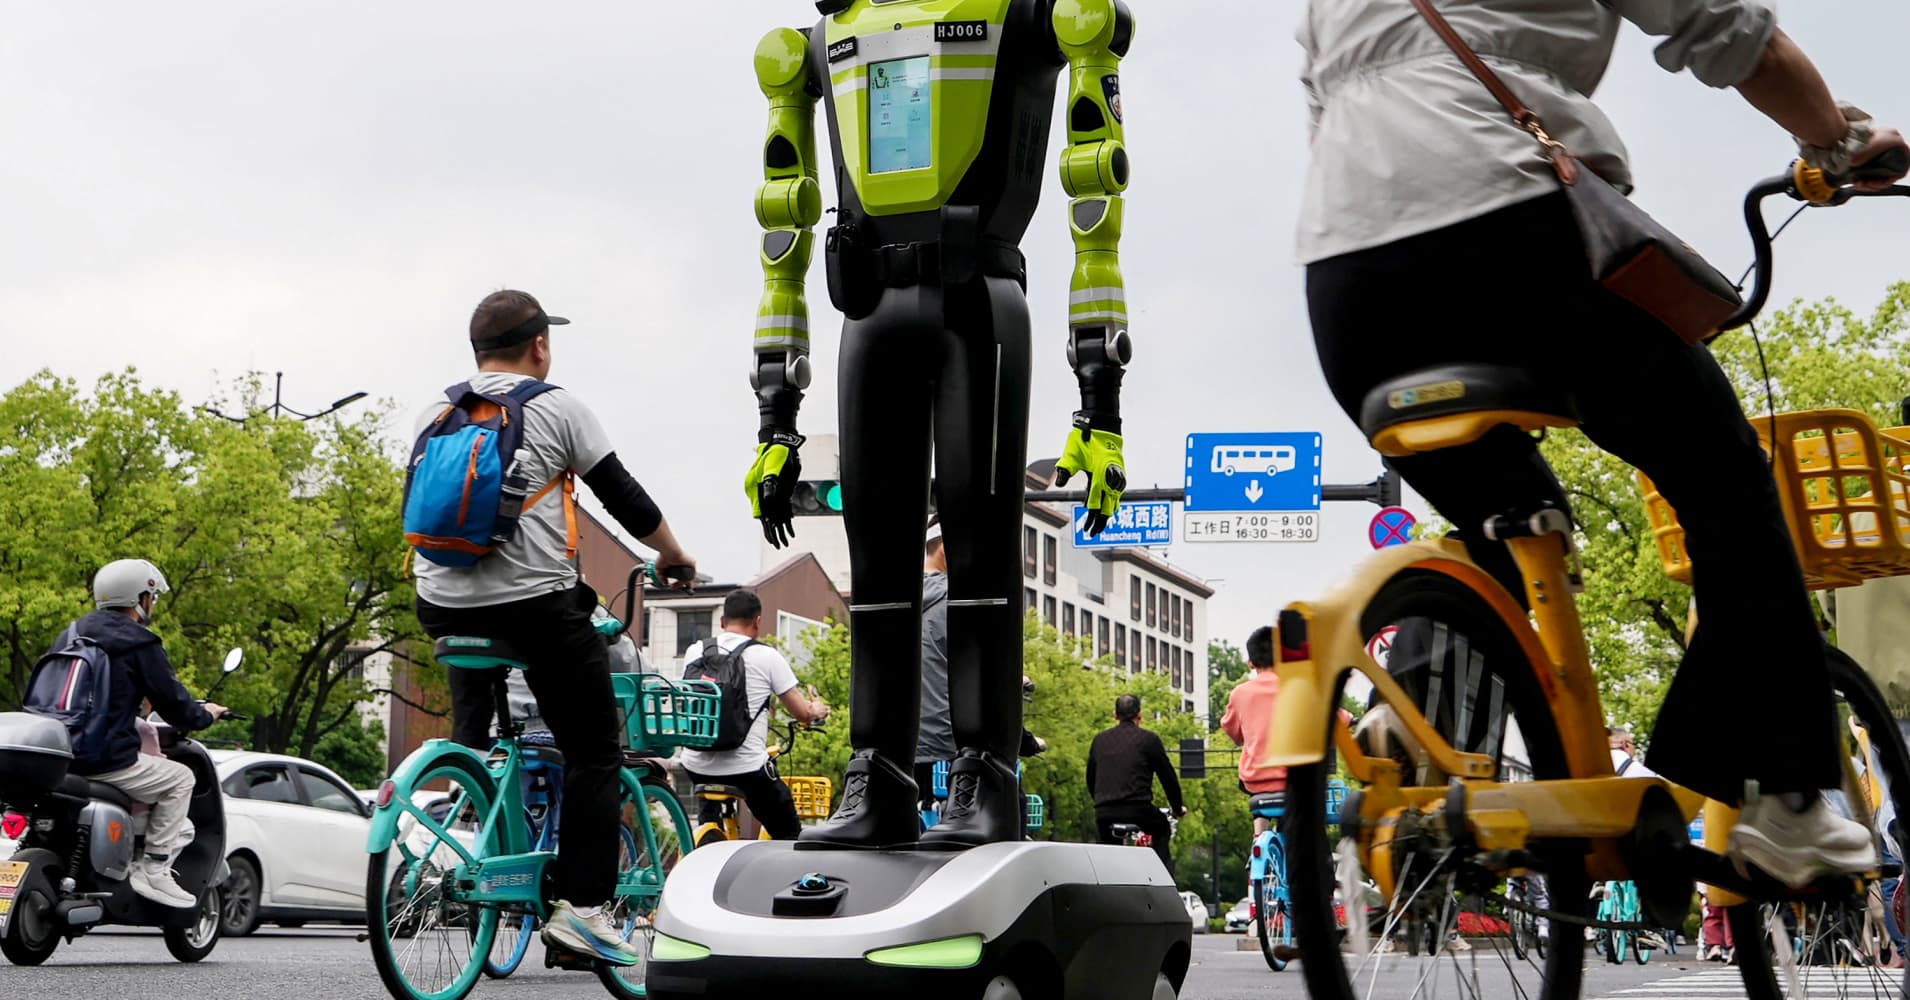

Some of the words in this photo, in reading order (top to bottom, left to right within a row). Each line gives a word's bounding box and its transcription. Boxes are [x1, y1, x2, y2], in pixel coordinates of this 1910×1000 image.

[937, 24, 984, 38] HJ006
[1190, 520, 1230, 535] 工作日
[1100, 530, 1142, 543] Huancheng
